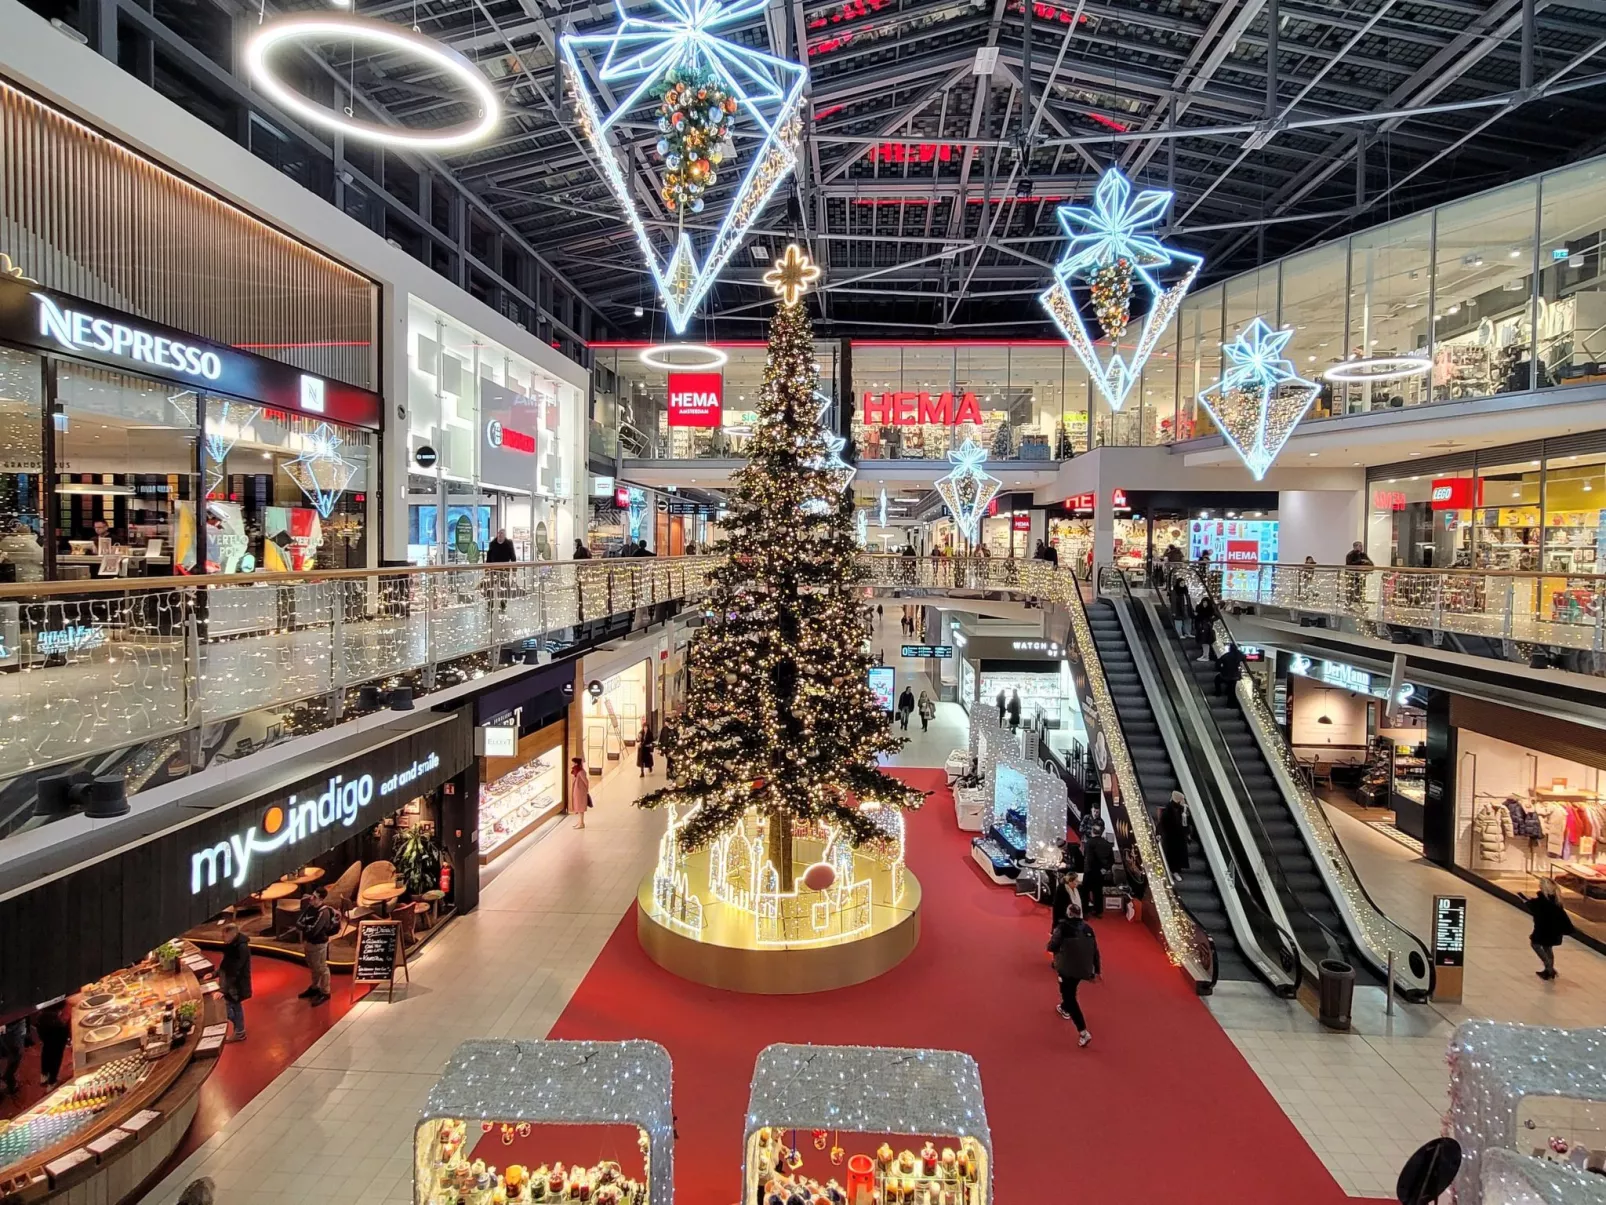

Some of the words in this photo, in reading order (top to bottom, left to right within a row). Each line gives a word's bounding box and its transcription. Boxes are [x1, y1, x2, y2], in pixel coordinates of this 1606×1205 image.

[31, 292, 221, 380] NESPRESSO
[671, 392, 719, 407] HEMA
[863, 391, 983, 425] HEMA
[1065, 488, 1127, 508] HEA
[1433, 486, 1452, 501] LEGO
[1228, 551, 1258, 560] HEMA
[1012, 641, 1047, 650] WATCH
[380, 777, 398, 795] eat
[399, 760, 418, 786] and
[417, 752, 440, 776] smile
